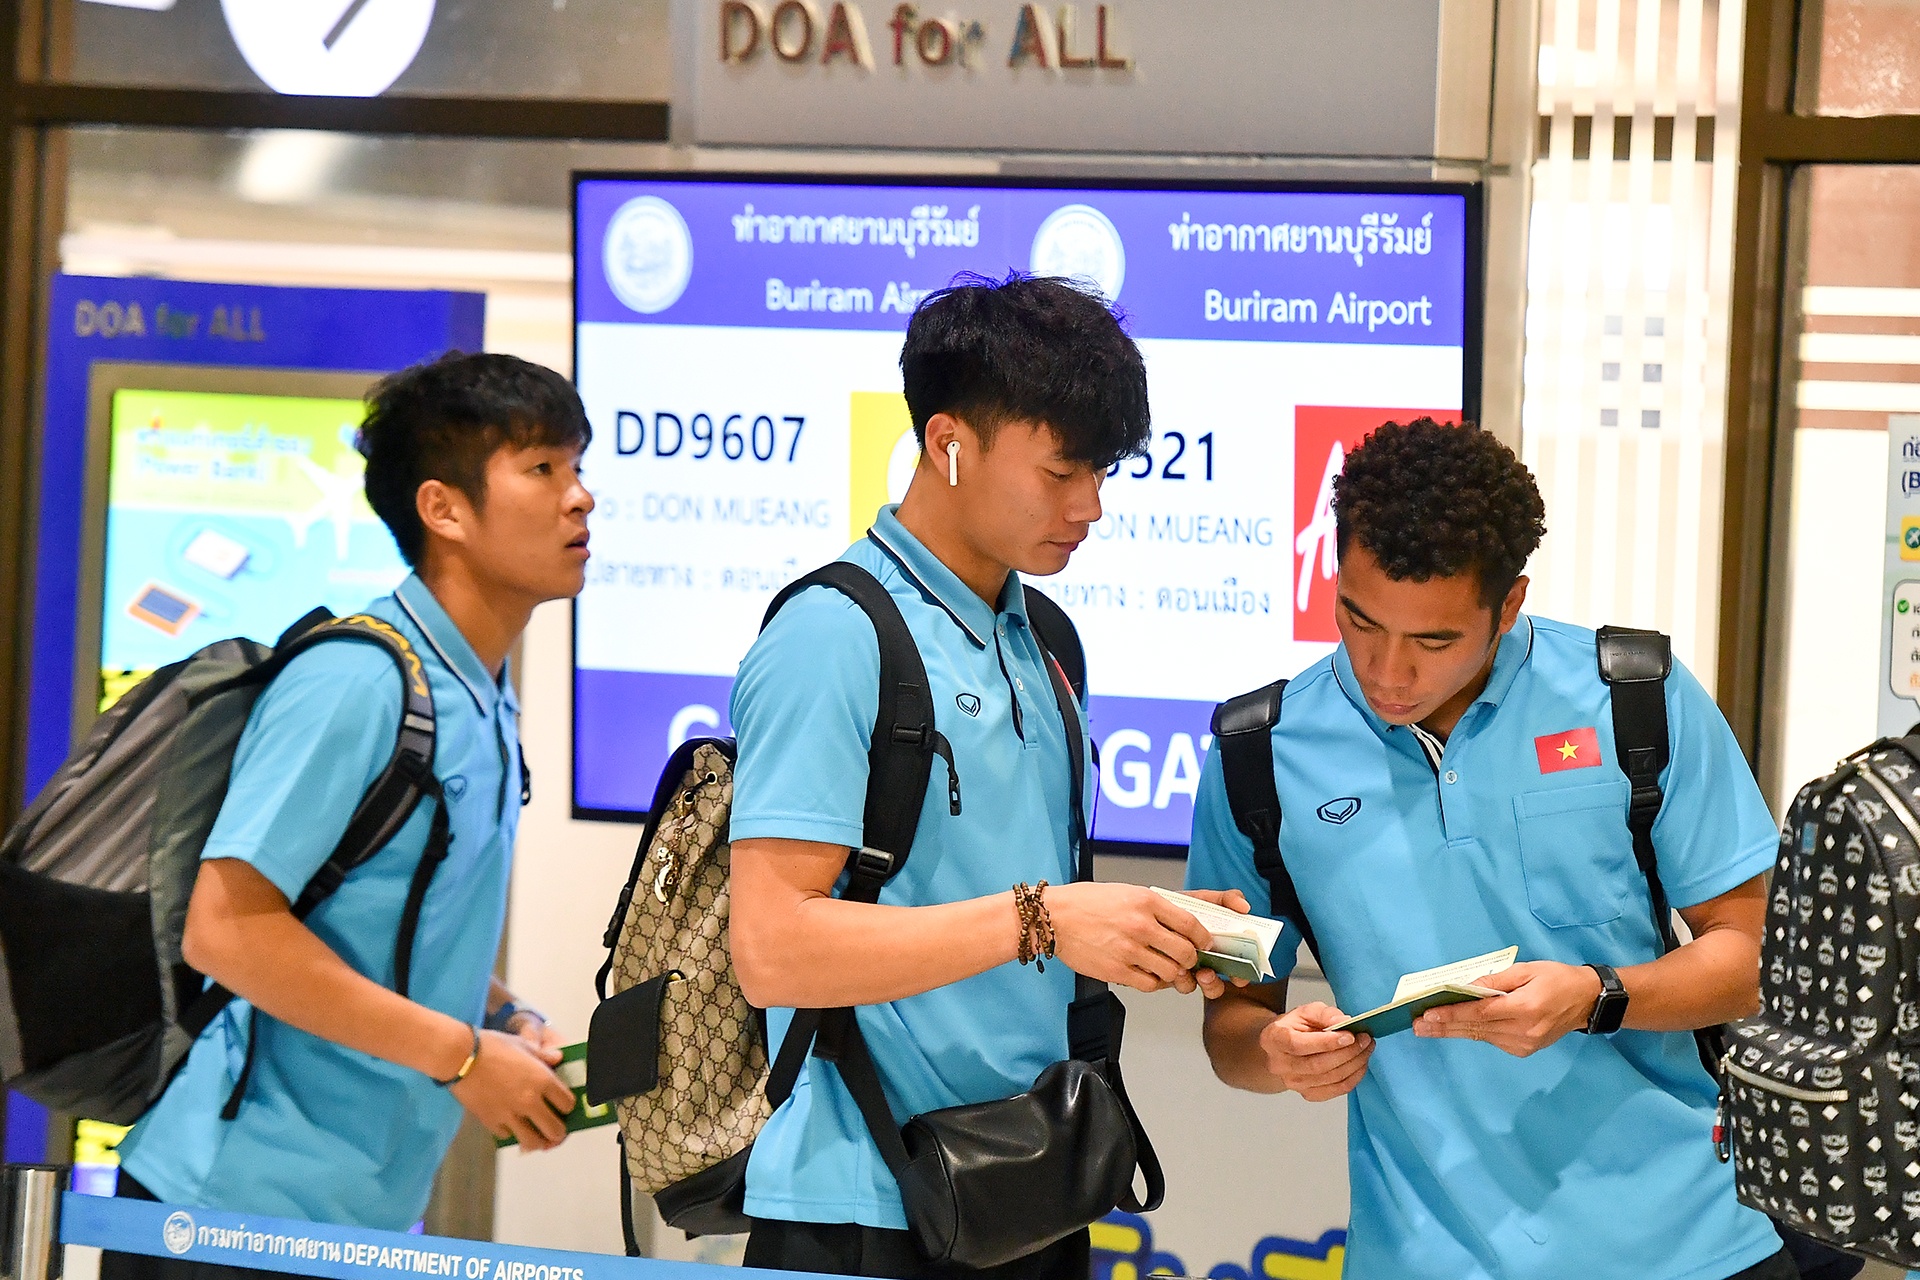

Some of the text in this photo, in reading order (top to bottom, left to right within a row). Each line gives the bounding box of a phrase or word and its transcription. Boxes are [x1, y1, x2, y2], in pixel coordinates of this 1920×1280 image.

[719, 1, 1136, 70] DOA for ALL
[731, 202, 981, 259] ท่าอากาศยานบุรีรัมย์
[1168, 211, 1433, 268] ท่าอากาศยานบุรีรัมย์
[765, 277, 874, 313] Buriram
[1204, 288, 1432, 332] Buriram Airport
[75, 299, 146, 339] DOA
[209, 304, 266, 342] ALL
[615, 410, 805, 463] DD9607
[642, 492, 703, 522] DON
[713, 497, 832, 529] MUEANG
[1093, 511, 1274, 546] ON MUEANG
[1156, 576, 1271, 616] ดอนเมือง
[1100, 728, 1213, 809] GA
[198, 1224, 341, 1263] กรมท่าอากาศยาน
[343, 1242, 584, 1280] DEPARTMENT OF AIRPORTS
